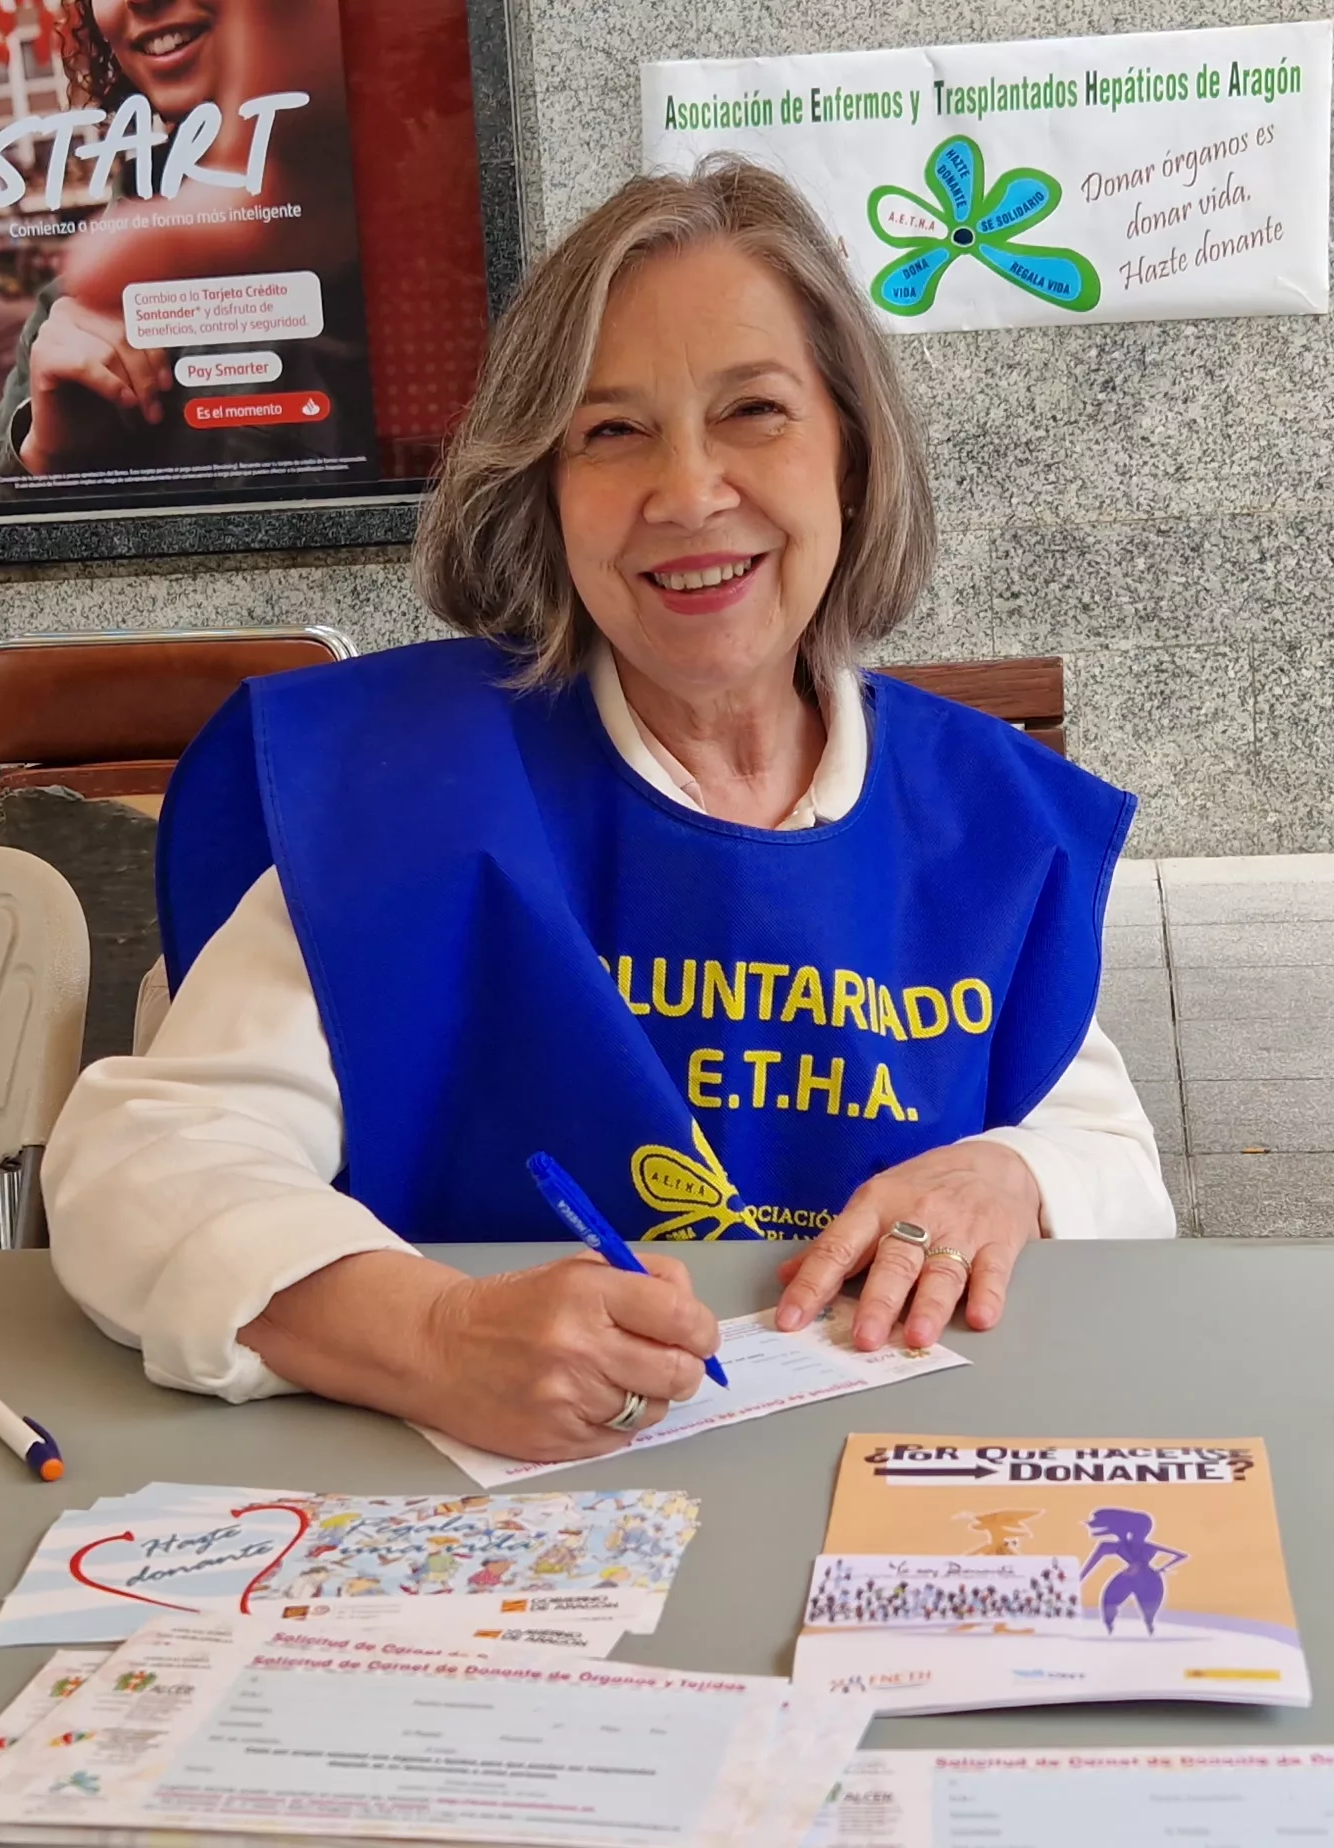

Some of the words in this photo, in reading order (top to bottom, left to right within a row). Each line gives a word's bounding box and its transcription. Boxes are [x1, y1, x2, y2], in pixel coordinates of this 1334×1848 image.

[665, 90, 773, 131] Asociación
[781, 89, 803, 125] de
[811, 86, 902, 123] Enfermos
[909, 89, 920, 125] y
[934, 73, 1078, 121] Trasplantados
[1085, 66, 1188, 113] Hepáticos
[1196, 63, 1220, 100] de
[1228, 56, 1302, 104] Aragón
[945, 149, 971, 180] HAZTE
[1080, 163, 1156, 203] Donar
[1162, 132, 1249, 188] órganos
[1255, 123, 1275, 146] es
[937, 164, 968, 209] DONANTE
[9, 220, 76, 238] Comienza
[78, 223, 87, 233] a
[90, 218, 128, 237] pagar
[132, 214, 149, 229] de
[152, 210, 193, 228] forma
[197, 209, 226, 224] más
[229, 203, 301, 223] inteligente
[980, 217, 995, 233] SE
[996, 191, 1045, 228] SOLIDARIO
[1126, 201, 1193, 240] donar
[1198, 171, 1252, 215] vida.
[902, 258, 930, 280] DONA
[1119, 246, 1188, 291] Hazte
[1195, 215, 1285, 267] donante
[135, 290, 177, 306] Cambia
[179, 293, 187, 303] a
[189, 290, 200, 302] la
[202, 287, 243, 303] Tarjeta
[245, 284, 288, 298] Crédito
[893, 286, 917, 299] VIDA
[1009, 262, 1045, 289] REGALA
[1046, 278, 1071, 296] VIDA
[137, 321, 197, 337] beneficios,
[200, 318, 238, 334] control
[241, 320, 249, 333] y
[250, 315, 309, 332] seguridad.
[204, 307, 212, 319] y
[213, 303, 257, 316] disfruta
[260, 302, 273, 313] de
[187, 364, 212, 381] Pay
[215, 362, 269, 377] Smarter
[197, 406, 210, 420] Es
[212, 405, 223, 419] el
[226, 403, 283, 418] momento
[598, 955, 993, 1043] LUNTARIADO
[687, 1048, 919, 1122] E.T.H.A.
[1008, 1459, 1255, 1482] DONANTE?
[140, 1523, 243, 1558] Hazte
[125, 1540, 275, 1587] donante
[252, 1654, 333, 1671] Solicitud
[338, 1659, 361, 1671] de
[435, 1664, 458, 1676] de
